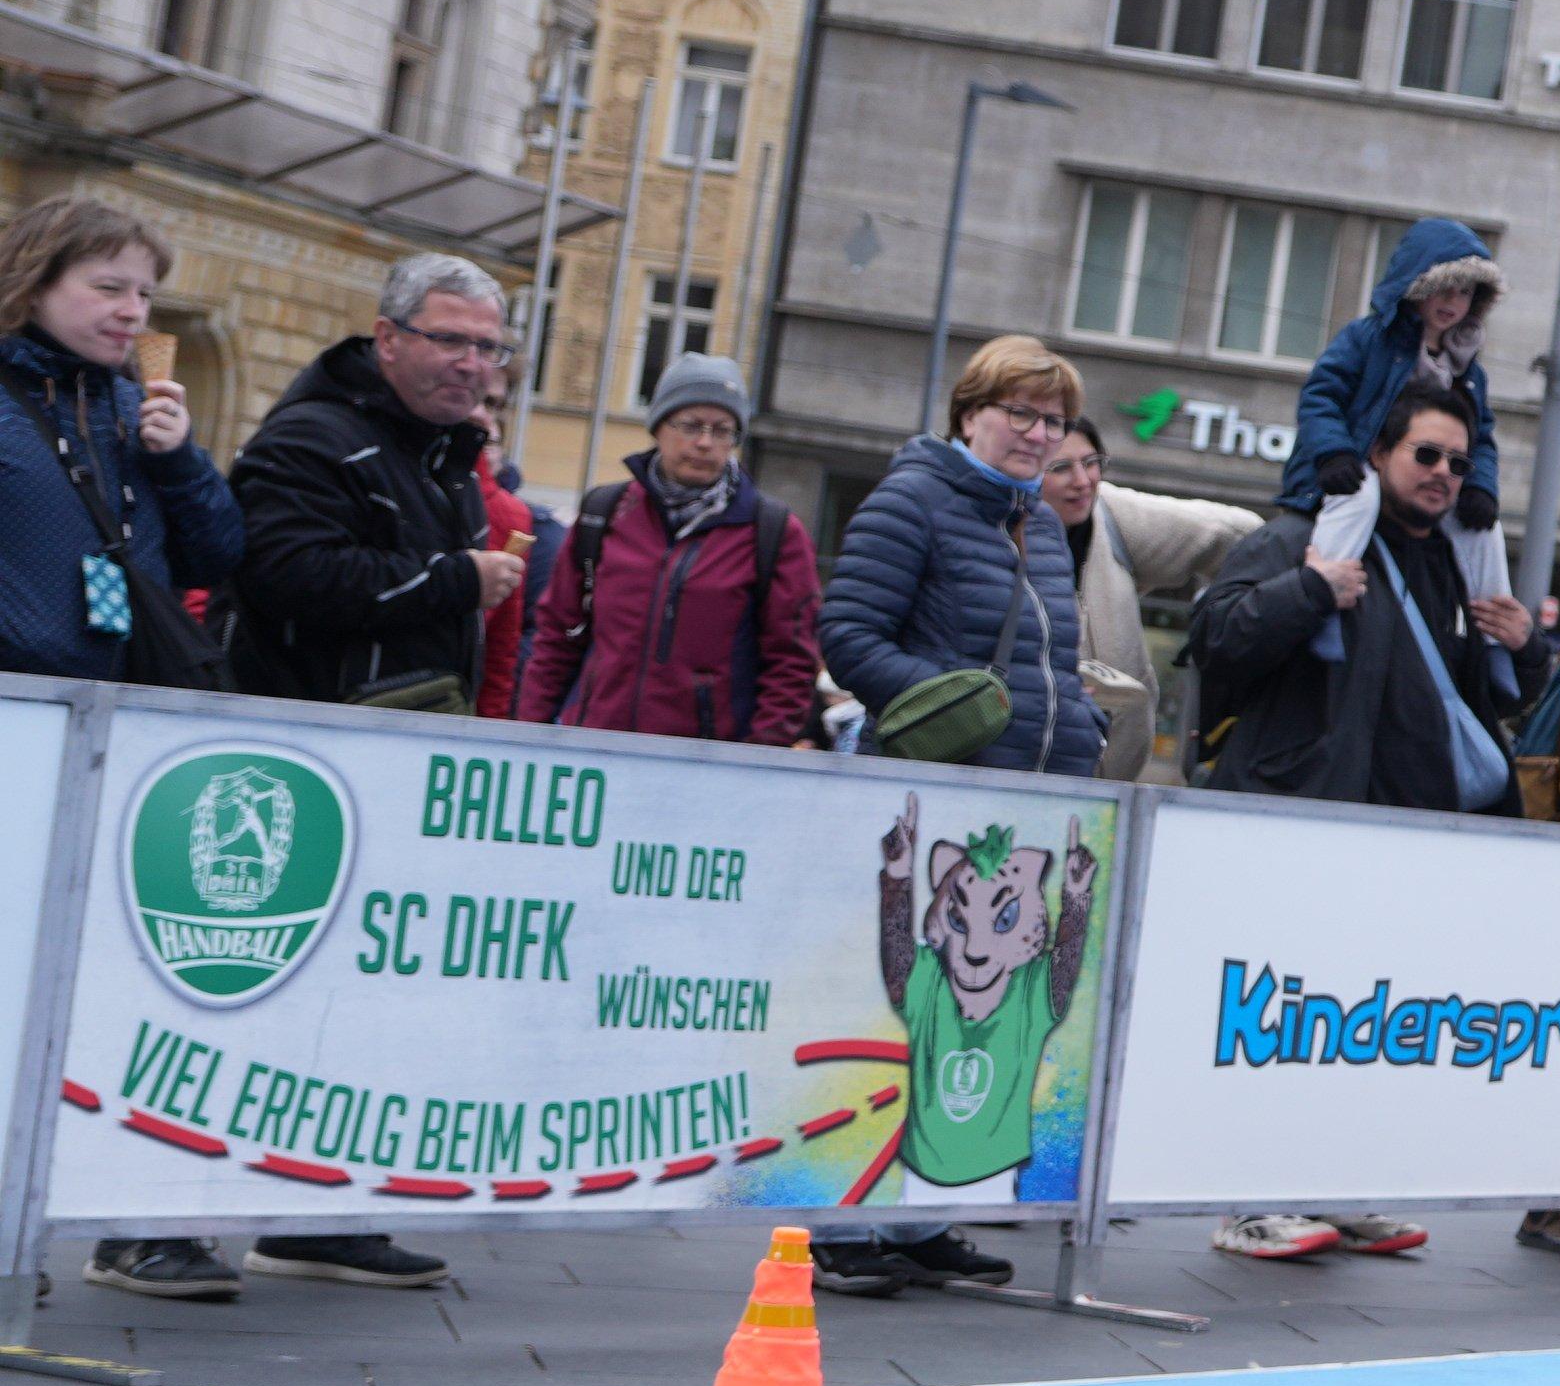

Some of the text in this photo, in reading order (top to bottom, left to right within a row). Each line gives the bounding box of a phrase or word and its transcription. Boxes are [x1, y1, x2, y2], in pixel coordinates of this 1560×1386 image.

[421, 754, 607, 848] BALLEO
[612, 841, 747, 902] UND DER
[155, 918, 297, 964] HANDBALL
[357, 889, 576, 982] SC DHFK
[598, 964, 771, 1032] WÜNSCHEN
[120, 1019, 750, 1174] VIEL ERFOLG BEIM SPRINTEN!
